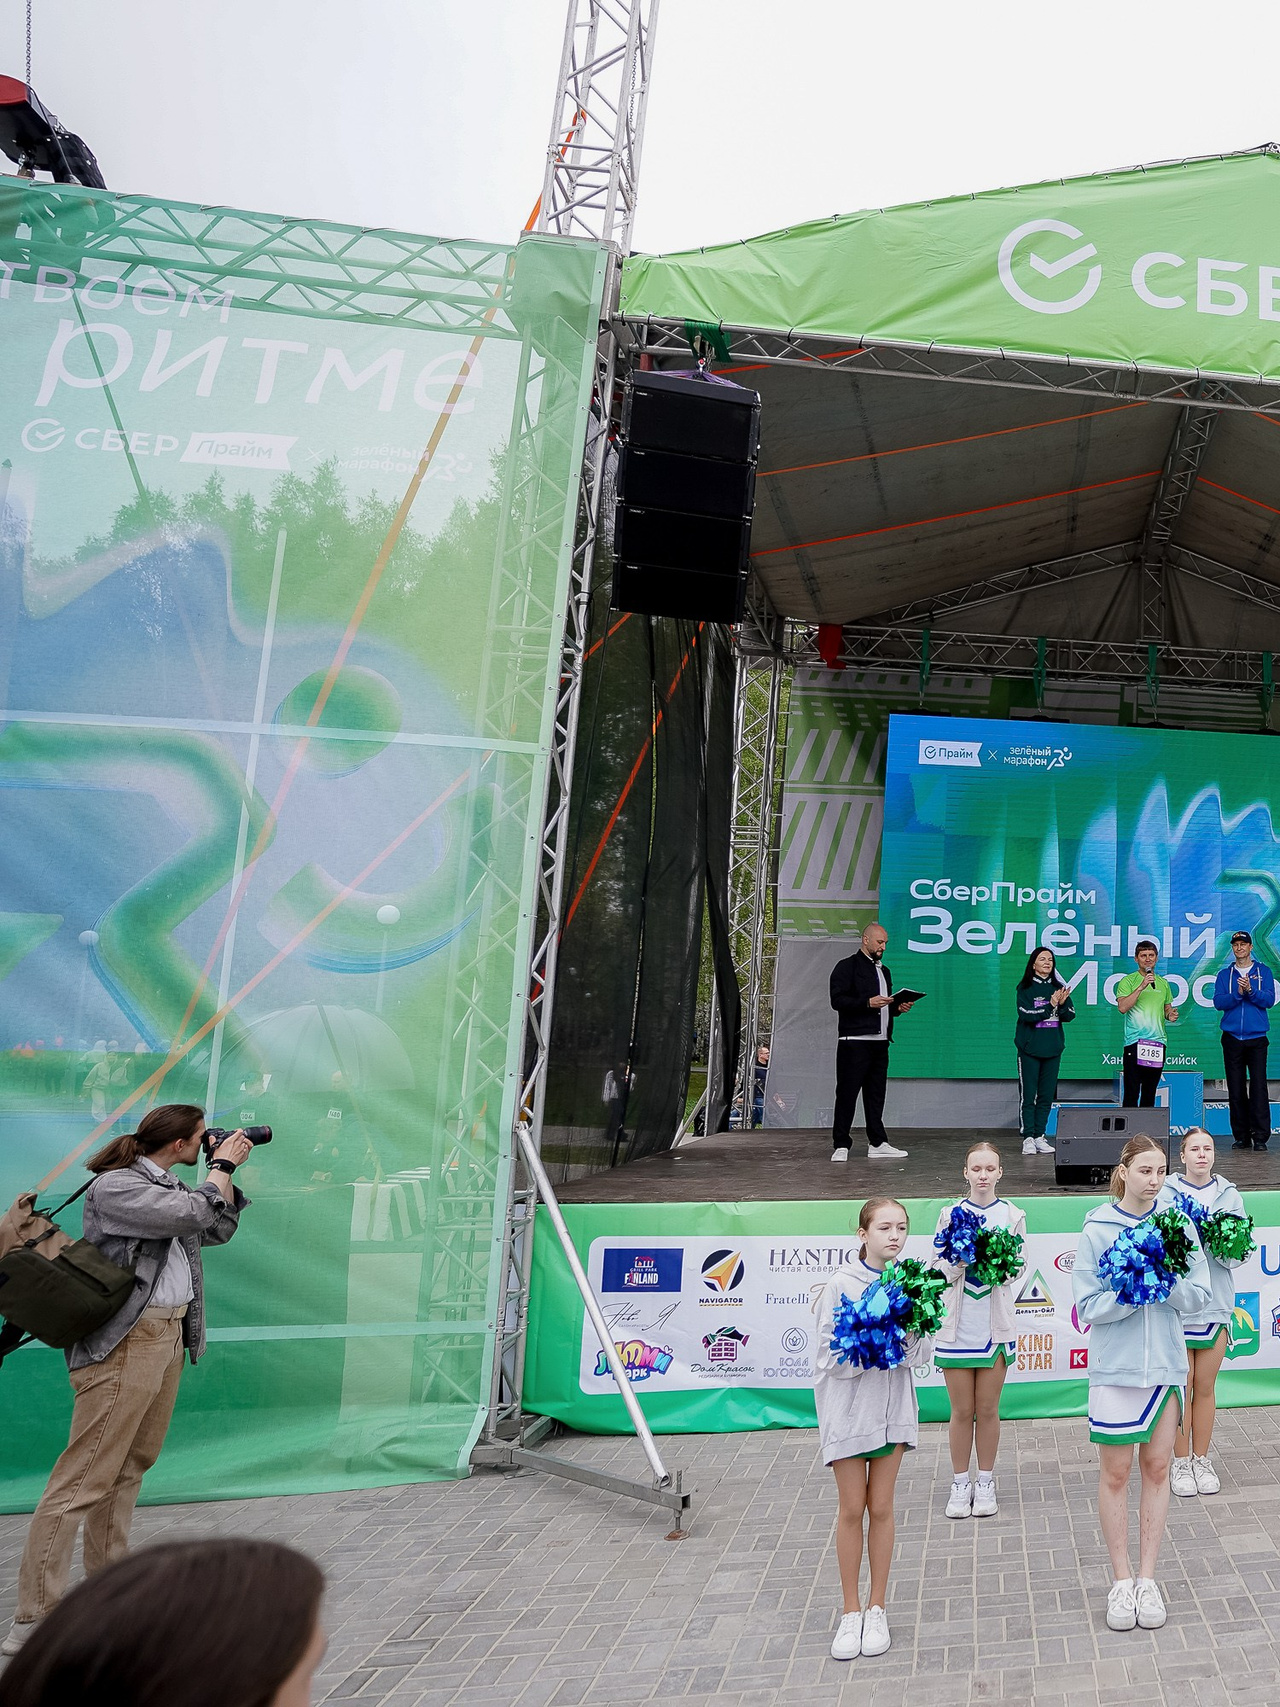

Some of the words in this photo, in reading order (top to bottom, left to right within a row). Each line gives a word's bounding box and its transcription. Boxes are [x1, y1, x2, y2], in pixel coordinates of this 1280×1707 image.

[35, 318, 484, 414] ритме
[75, 428, 179, 456] СБЕР
[196, 440, 273, 459] Прайм
[938, 747, 973, 759] Прайм
[1009, 745, 1051, 756] зелёный
[1003, 756, 1047, 767] марафон
[909, 879, 1096, 907] СберПрайм
[907, 906, 1216, 958] Зелёный
[1140, 1049, 1160, 1058] 2185
[765, 1294, 809, 1304] Fratelli
[1018, 1334, 1053, 1352] KINO
[1018, 1353, 1052, 1371] STAR
[625, 1368, 648, 1379] арк
